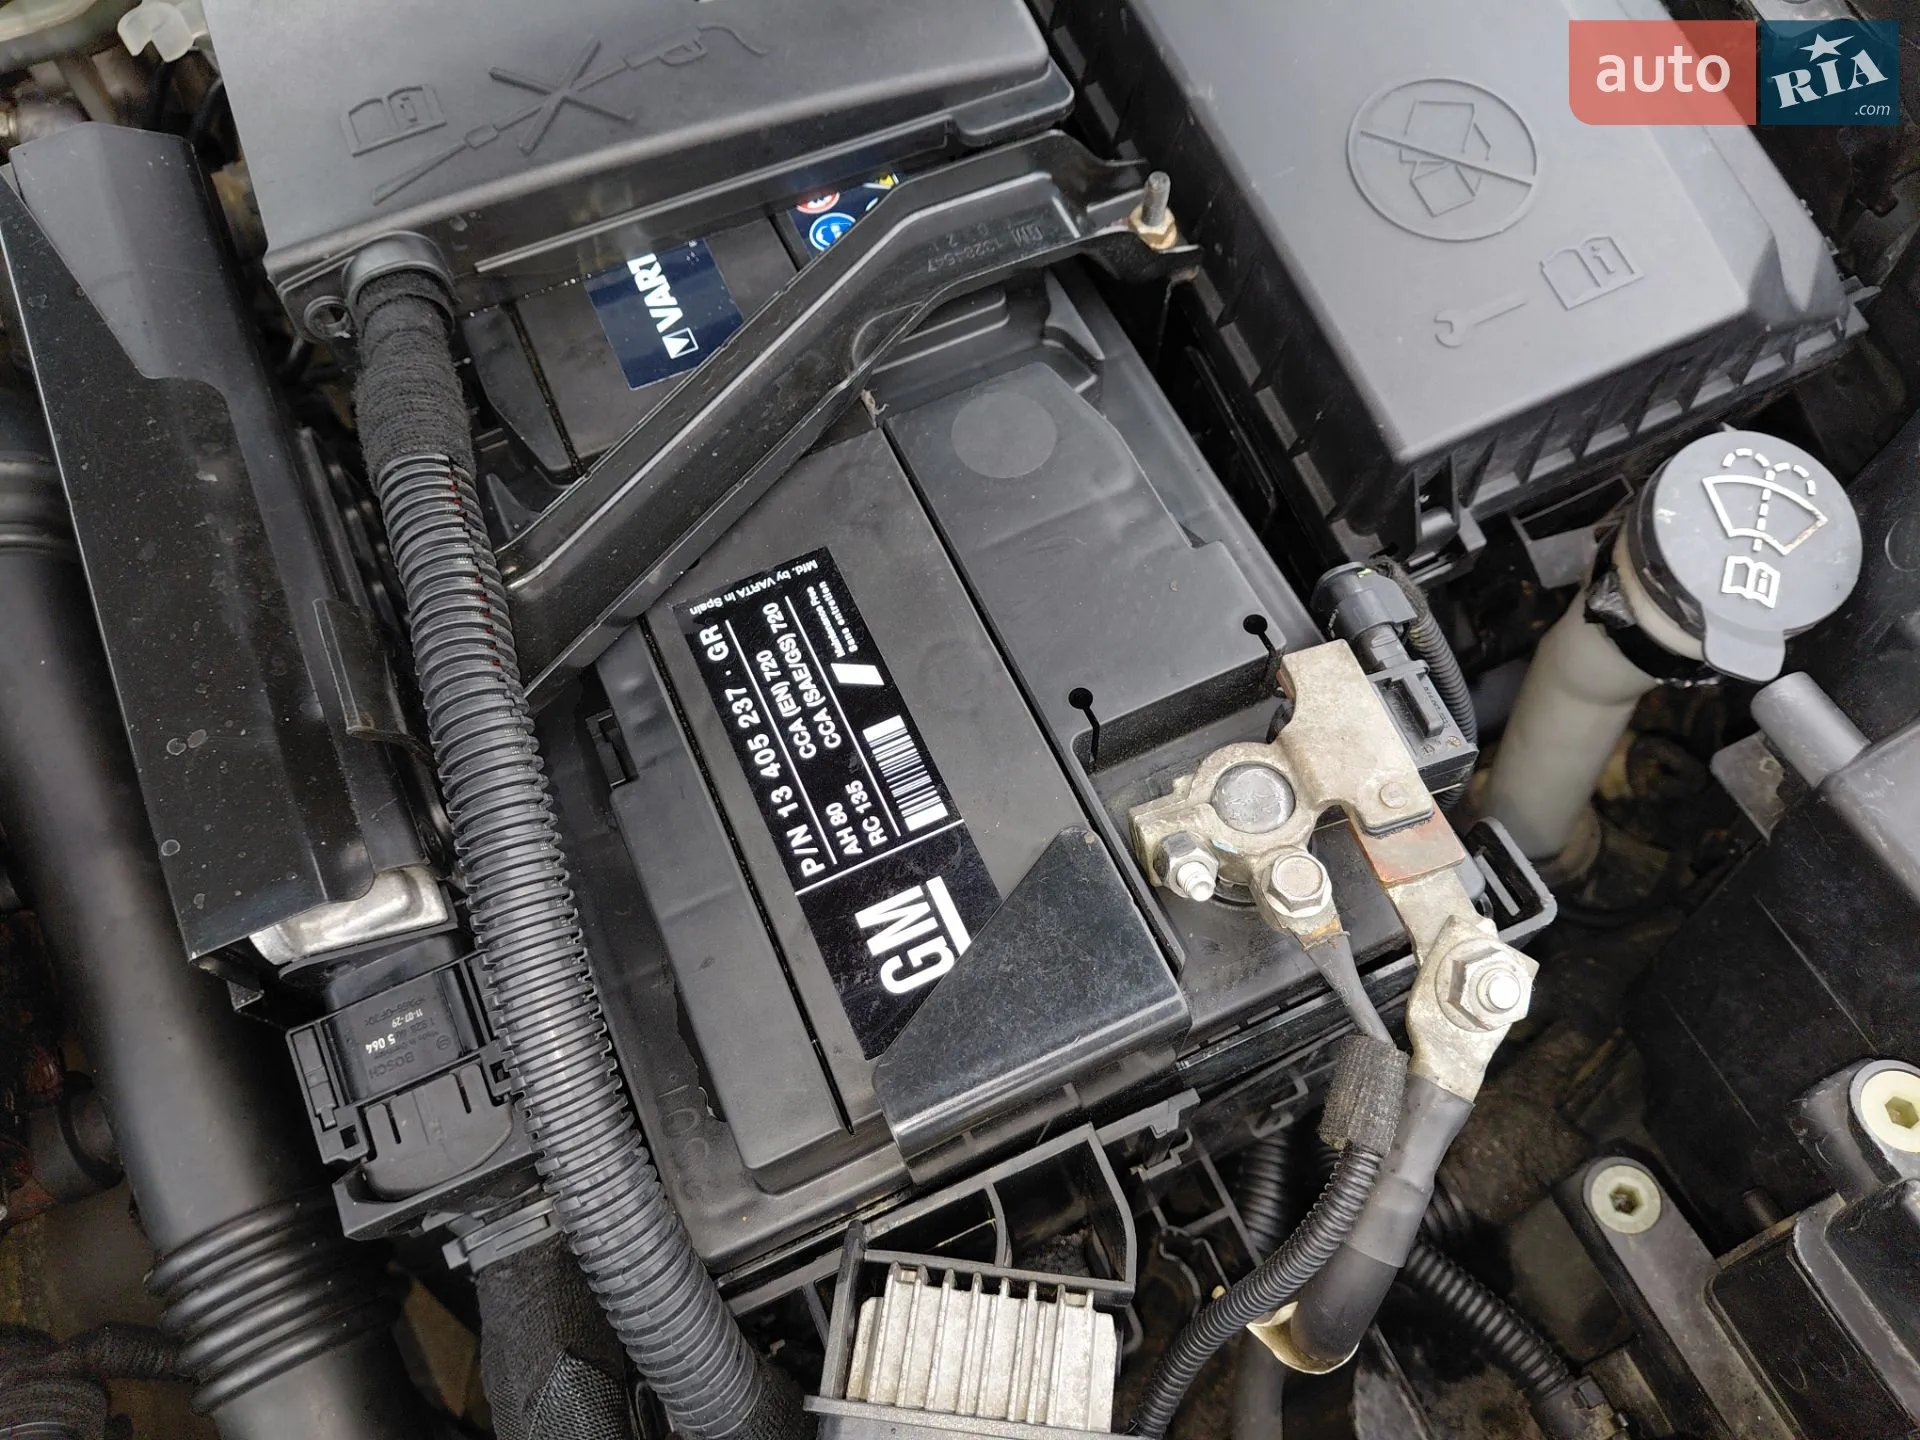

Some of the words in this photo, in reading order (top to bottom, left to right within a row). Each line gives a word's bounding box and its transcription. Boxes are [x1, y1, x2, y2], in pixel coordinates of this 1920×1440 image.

[627, 253, 683, 333] VART
[777, 570, 791, 581] by
[792, 560, 818, 575] Mfd.
[736, 577, 776, 598] VARTA
[689, 597, 723, 615] Spain
[763, 603, 787, 633] 720
[700, 625, 729, 661] GR
[756, 650, 781, 682] 720
[777, 633, 826, 707] (SAE/GS)
[725, 688, 760, 728] 237
[771, 681, 801, 717] (EN)
[789, 717, 816, 759] CCA
[813, 707, 841, 748] CCA
[747, 734, 780, 777] 405
[771, 786, 798, 817] 13
[845, 780, 871, 813] 135
[826, 803, 847, 826] 80
[836, 826, 863, 854] AH
[862, 816, 887, 846] RC
[787, 824, 825, 877] P/N
[853, 884, 954, 995] GM
[369, 1052, 414, 1078] BOSCH
